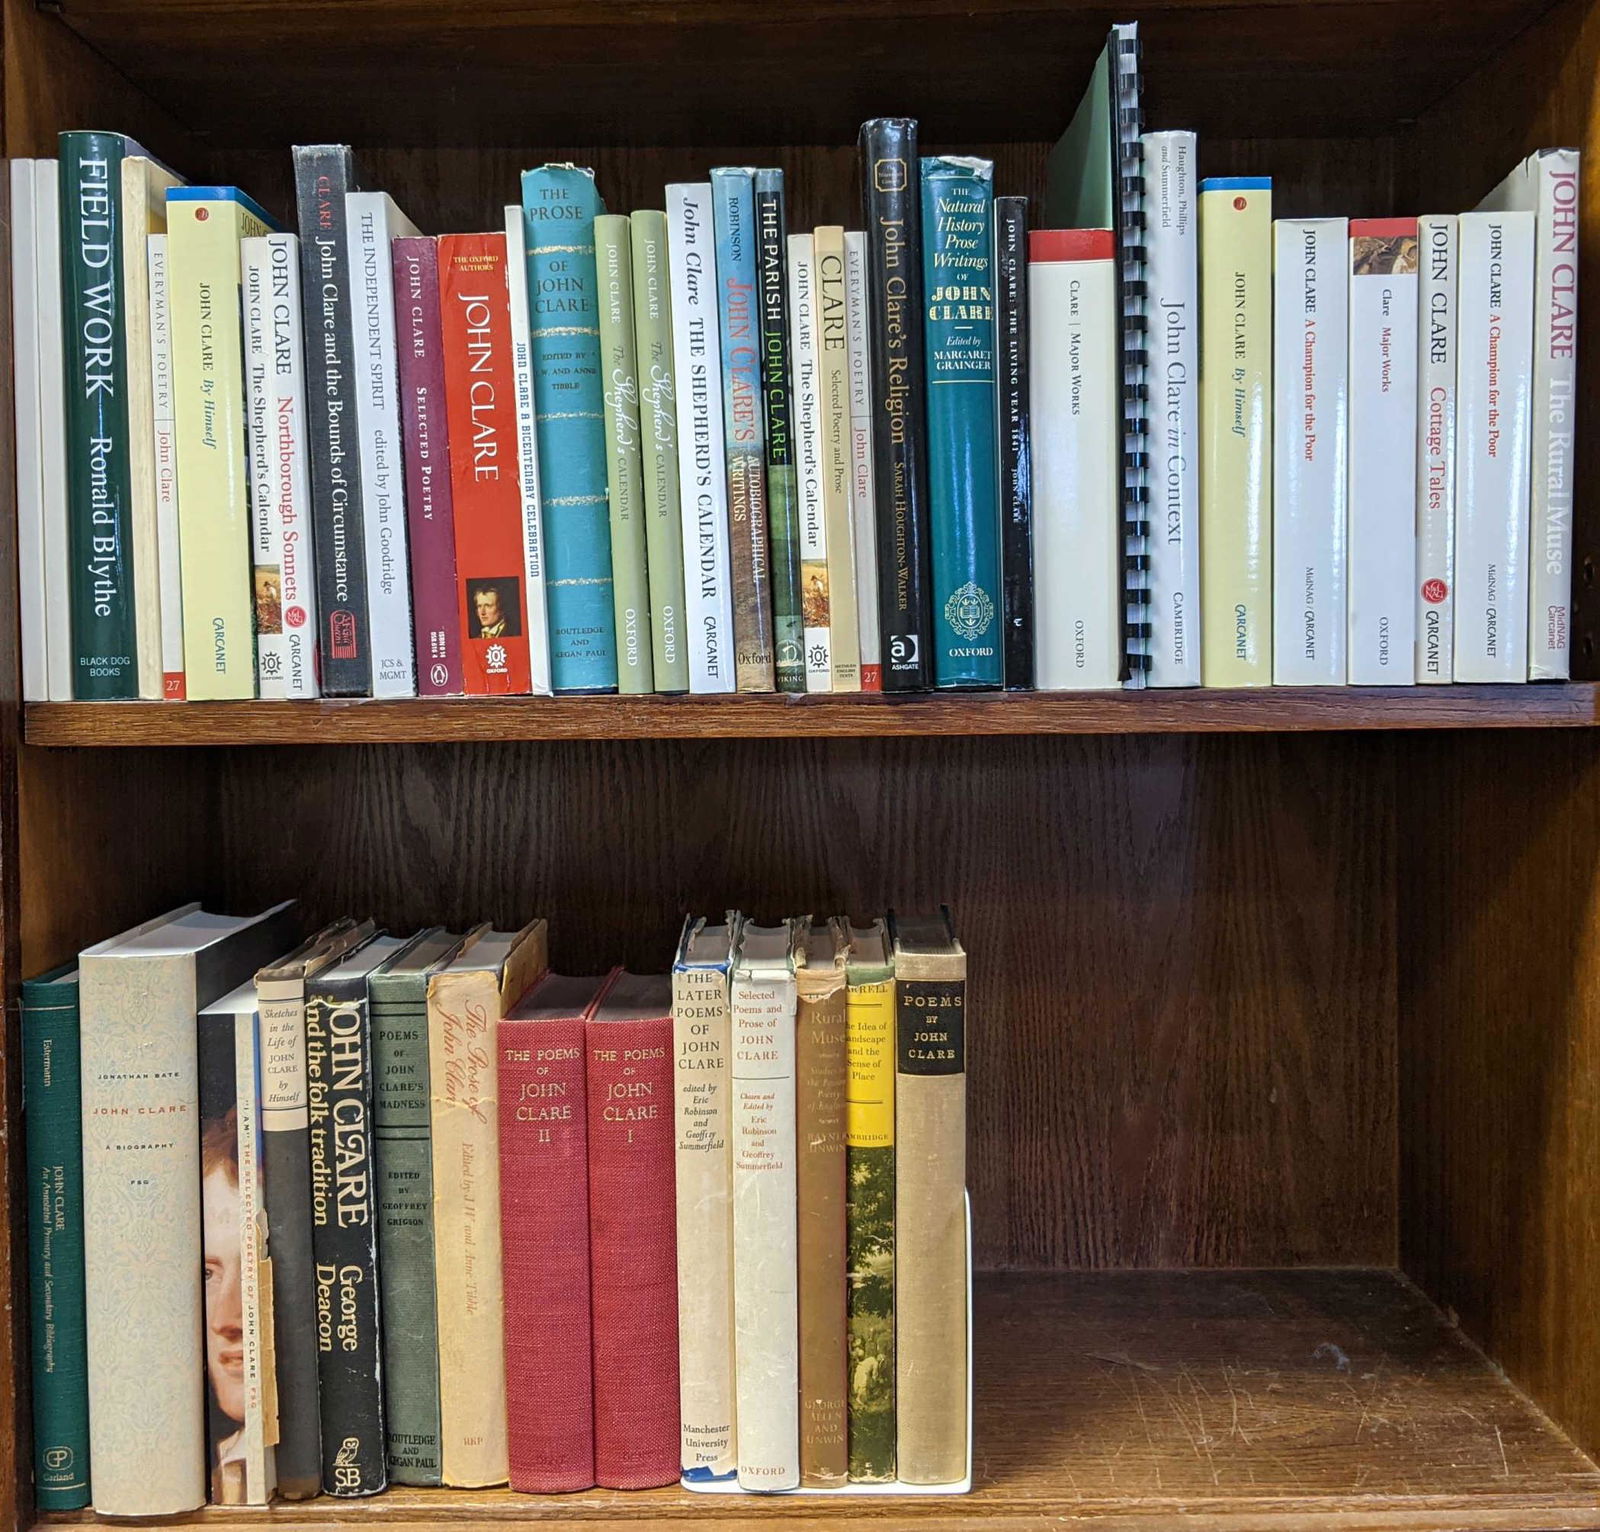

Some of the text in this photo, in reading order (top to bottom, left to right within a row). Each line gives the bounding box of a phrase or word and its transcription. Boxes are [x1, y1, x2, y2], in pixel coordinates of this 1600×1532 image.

[318, 176, 331, 230] CLARE
[541, 189, 569, 200] THE
[530, 205, 583, 221] PROSE
[937, 199, 985, 214] Natural
[729, 197, 742, 262] ROBINSON
[938, 219, 985, 235] History
[945, 234, 978, 249] Prose
[318, 239, 337, 279] John
[550, 261, 568, 272] OF
[934, 252, 988, 270] Writings
[79, 157, 113, 400] FIELD WORK
[537, 278, 584, 296] JOHN
[931, 286, 990, 301] JOHN
[1381, 289, 1393, 316] Clare
[322, 284, 339, 328] Clare
[361, 212, 384, 410] THE INDEPENDENT SPIRIT
[408, 257, 423, 359] JOHN CLARE
[535, 299, 591, 314] CLARE
[819, 255, 844, 351] CLARE
[763, 200, 786, 459] THE PARISH JOHN CLARE
[879, 218, 909, 444] John Clare's Religion
[324, 332, 339, 364] and
[1301, 229, 1318, 461] JOHN CLARE A Champion for the Poor
[200, 283, 216, 448] JOHN CLARE By Himself
[726, 277, 756, 442] JOHN CLARE'S
[1379, 327, 1393, 392] Major Works
[1426, 222, 1448, 509] JOHN CLARE Cottage Tales
[1546, 171, 1576, 574] JOHN CLARE The Rural Muse
[326, 368, 342, 396] the
[459, 293, 497, 482] JOHN CLARE
[682, 197, 717, 599] John Clare THE SHEPHERD'S CALENDAR
[269, 240, 298, 600] JOHN CLARE Northborough Sonnets
[1160, 298, 1188, 545] John Clare in Context
[326, 400, 345, 463] Bounds
[831, 369, 846, 493] Selected Poetry and Prose
[330, 467, 346, 485] of
[732, 457, 746, 521] WRITINGS
[373, 430, 394, 594] edited by John Goodridge
[89, 436, 116, 616] Ronald Blythe
[331, 489, 351, 601] Circumstance
[1172, 592, 1185, 665] CAMBRIDGE
[1548, 605, 1557, 649] Carcanet
[1556, 605, 1565, 649] MidNAG
[212, 617, 226, 674] CARCANET
[625, 609, 637, 666] OXFORD
[703, 615, 719, 678] CARCANET
[1074, 620, 1085, 668] OXFORD
[1379, 616, 1390, 665] OXFORD
[1426, 610, 1441, 675] CARCANET
[740, 652, 771, 664] Oxford
[949, 647, 993, 657] OXFORD
[80, 657, 130, 666] BLACK DOG
[289, 634, 302, 690] CARCANET
[90, 668, 120, 677] BOOKS
[687, 973, 712, 984] THE
[678, 989, 722, 1000] LATER
[904, 995, 962, 1006] POEMS
[264, 1009, 298, 1018] Sketches
[677, 1007, 723, 1018] POEMS
[926, 1015, 938, 1024] BY
[380, 1031, 418, 1041] POEMS
[690, 1025, 709, 1036] OF
[914, 1032, 948, 1042] JOHN
[683, 1041, 719, 1054] JOHN
[742, 1036, 774, 1044] JOHN
[44, 1040, 52, 1086] Estermann
[269, 1054, 294, 1063] JOHN
[506, 1048, 579, 1060] THE POEMS
[594, 1048, 664, 1060] THE POEMS
[737, 1051, 778, 1060] CLARE
[908, 1049, 956, 1059] CLARE
[268, 1065, 298, 1073] CLARE
[385, 1065, 414, 1074] JOHN
[537, 1066, 548, 1075] OF
[624, 1067, 636, 1075] OF
[678, 1058, 724, 1070] CLARE
[269, 1092, 300, 1102] Himself
[380, 1084, 423, 1092] CLARE'S
[520, 1083, 566, 1100] JOHN
[606, 1082, 652, 1100] JOHN
[138, 1105, 187, 1114] CLARE
[308, 995, 332, 1225] and the folk tradition
[328, 996, 367, 1228] JOHN CLARE
[516, 1106, 571, 1120] CLARE
[603, 1105, 657, 1120] CLARE
[540, 1129, 551, 1141] II
[628, 1129, 633, 1142] I
[316, 1262, 336, 1352] Deacon
[338, 1264, 363, 1351] George
[683, 1424, 729, 1433] Manchester
[686, 1439, 728, 1449] University
[696, 1453, 718, 1461] Press
[335, 1468, 361, 1487] SB
[741, 1467, 785, 1475] OXFORD
